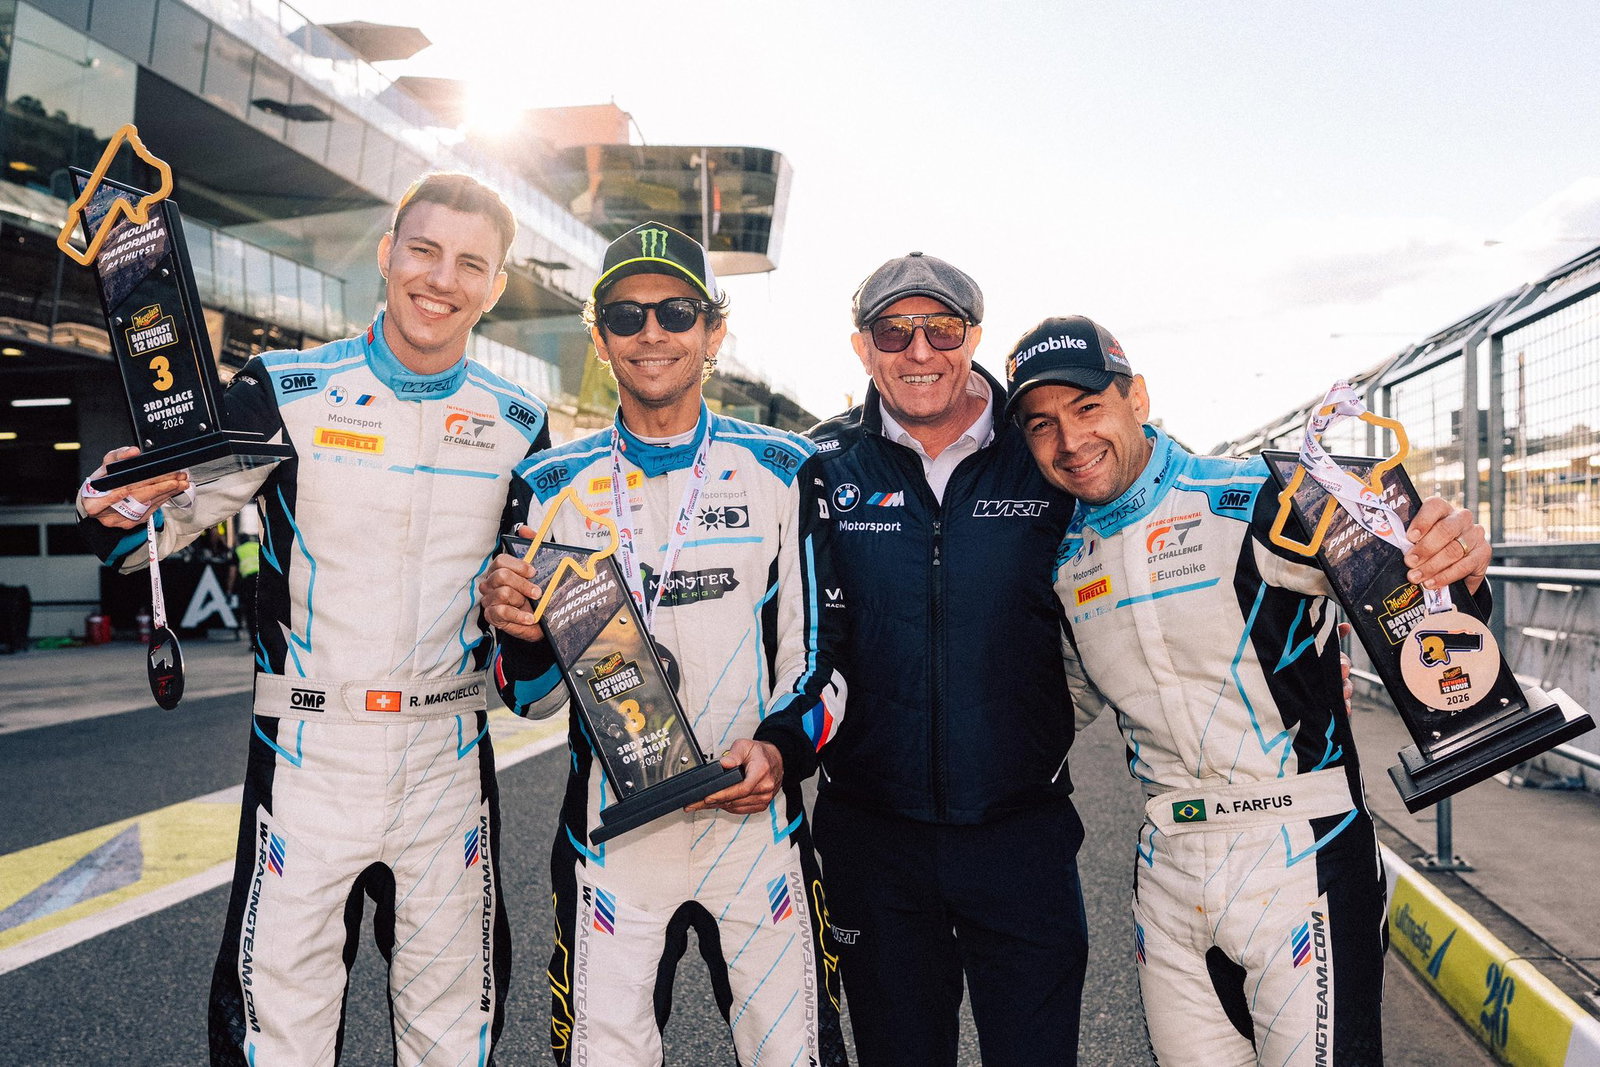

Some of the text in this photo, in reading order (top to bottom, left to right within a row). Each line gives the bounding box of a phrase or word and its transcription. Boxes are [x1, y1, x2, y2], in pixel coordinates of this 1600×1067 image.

[118, 217, 159, 242] MOUNT
[101, 228, 165, 263] PANORAMA
[131, 323, 170, 343] BATHURST
[134, 332, 173, 352] 12 HOUR
[1015, 335, 1087, 368] Eurobike
[149, 355, 174, 391] 3
[281, 376, 316, 390] OMP
[402, 374, 457, 392] WRT
[143, 390, 194, 413] 3RD PLACE
[147, 401, 194, 423] OUTRIGHT
[162, 416, 184, 430] 2026
[328, 413, 383, 429] Motorsport
[508, 404, 535, 425] OMP
[320, 430, 379, 451] PIRELLI
[443, 434, 496, 450] GT CHALLENGE
[763, 447, 798, 469] OMP
[537, 468, 568, 489] OMP
[972, 500, 1049, 517] WRT
[1098, 487, 1147, 530] WRT
[1219, 493, 1250, 506] OMP
[839, 520, 901, 533] Motorsport
[1147, 544, 1203, 564] GT CHALLENGE
[1073, 563, 1103, 582] Motorsport
[1157, 563, 1206, 581] Eurobike
[566, 569, 608, 600] MOUNT
[649, 573, 731, 594] MONSTER
[1078, 579, 1107, 604] PIRELLI
[551, 579, 616, 622] PANORAMA
[594, 667, 636, 692] BATHURST
[599, 675, 641, 700] 12 HOUR
[1441, 677, 1467, 687] BATHURST
[1442, 682, 1469, 693] 12 HOUR
[291, 693, 325, 708] OMP
[410, 684, 479, 707] R. MARCIELLO
[1446, 693, 1470, 706] 2026
[618, 699, 646, 733] 3
[617, 727, 669, 756] 3RD PLACE
[622, 737, 671, 765] OUTRIGHT
[640, 754, 663, 769] 2026
[1215, 795, 1293, 815] A. FARFUS
[480, 816, 493, 1013] W-RACINGTEAM.COM
[237, 821, 269, 1034] W-RACINGTEAM.COM
[1480, 962, 1516, 1049] 26
